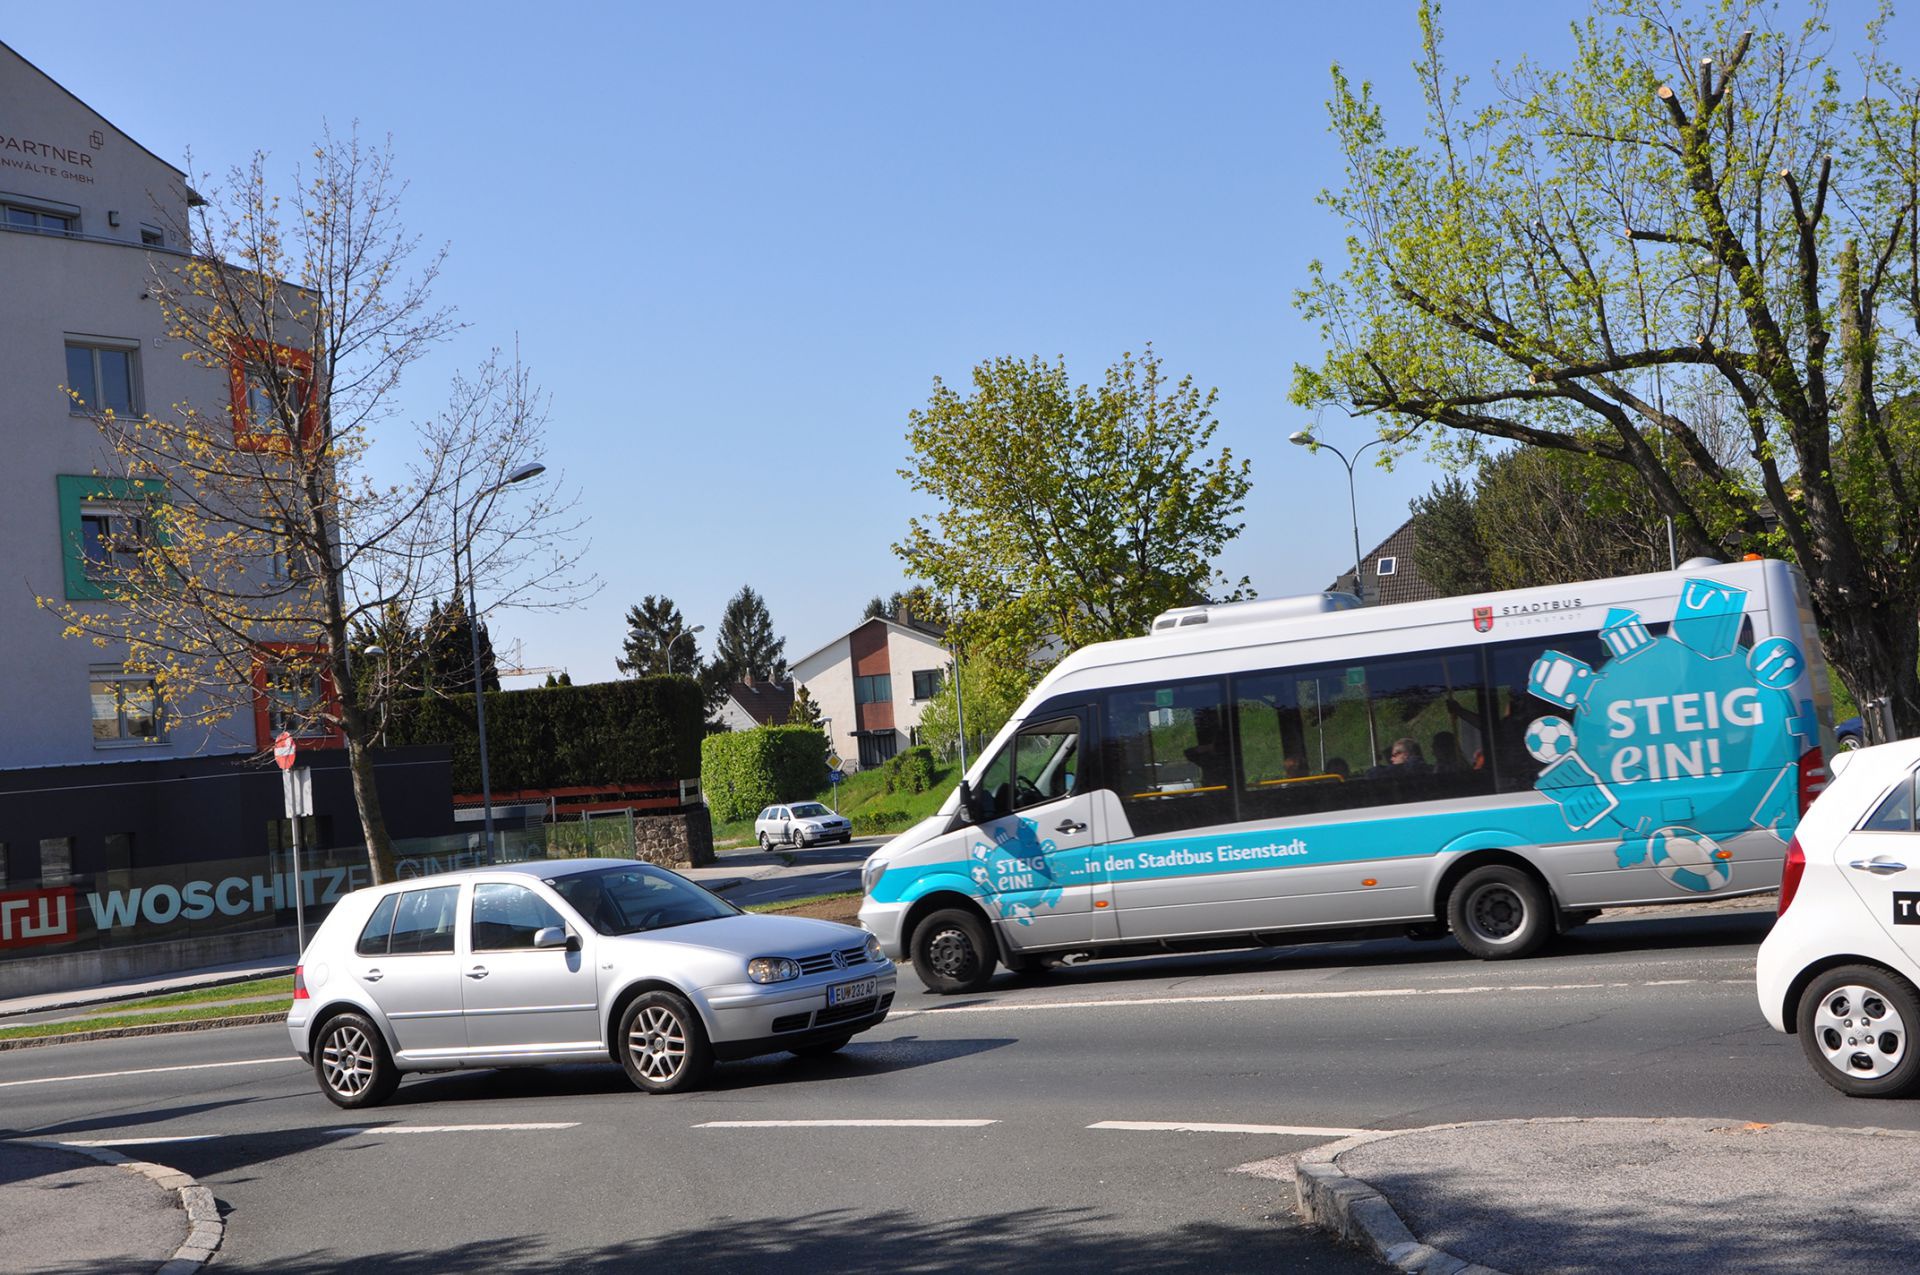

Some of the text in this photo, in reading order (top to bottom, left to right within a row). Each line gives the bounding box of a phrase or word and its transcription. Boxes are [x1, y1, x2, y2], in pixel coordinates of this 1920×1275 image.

[0, 158, 95, 185] NWÄLTE GMBH
[1502, 598, 1582, 615] STADTBUS
[1607, 687, 1764, 738] STEIG
[996, 856, 1045, 874] STEIG
[1104, 854, 1135, 872] den
[1138, 848, 1213, 869] Stadtbus
[1217, 838, 1308, 862] Eisenstadt
